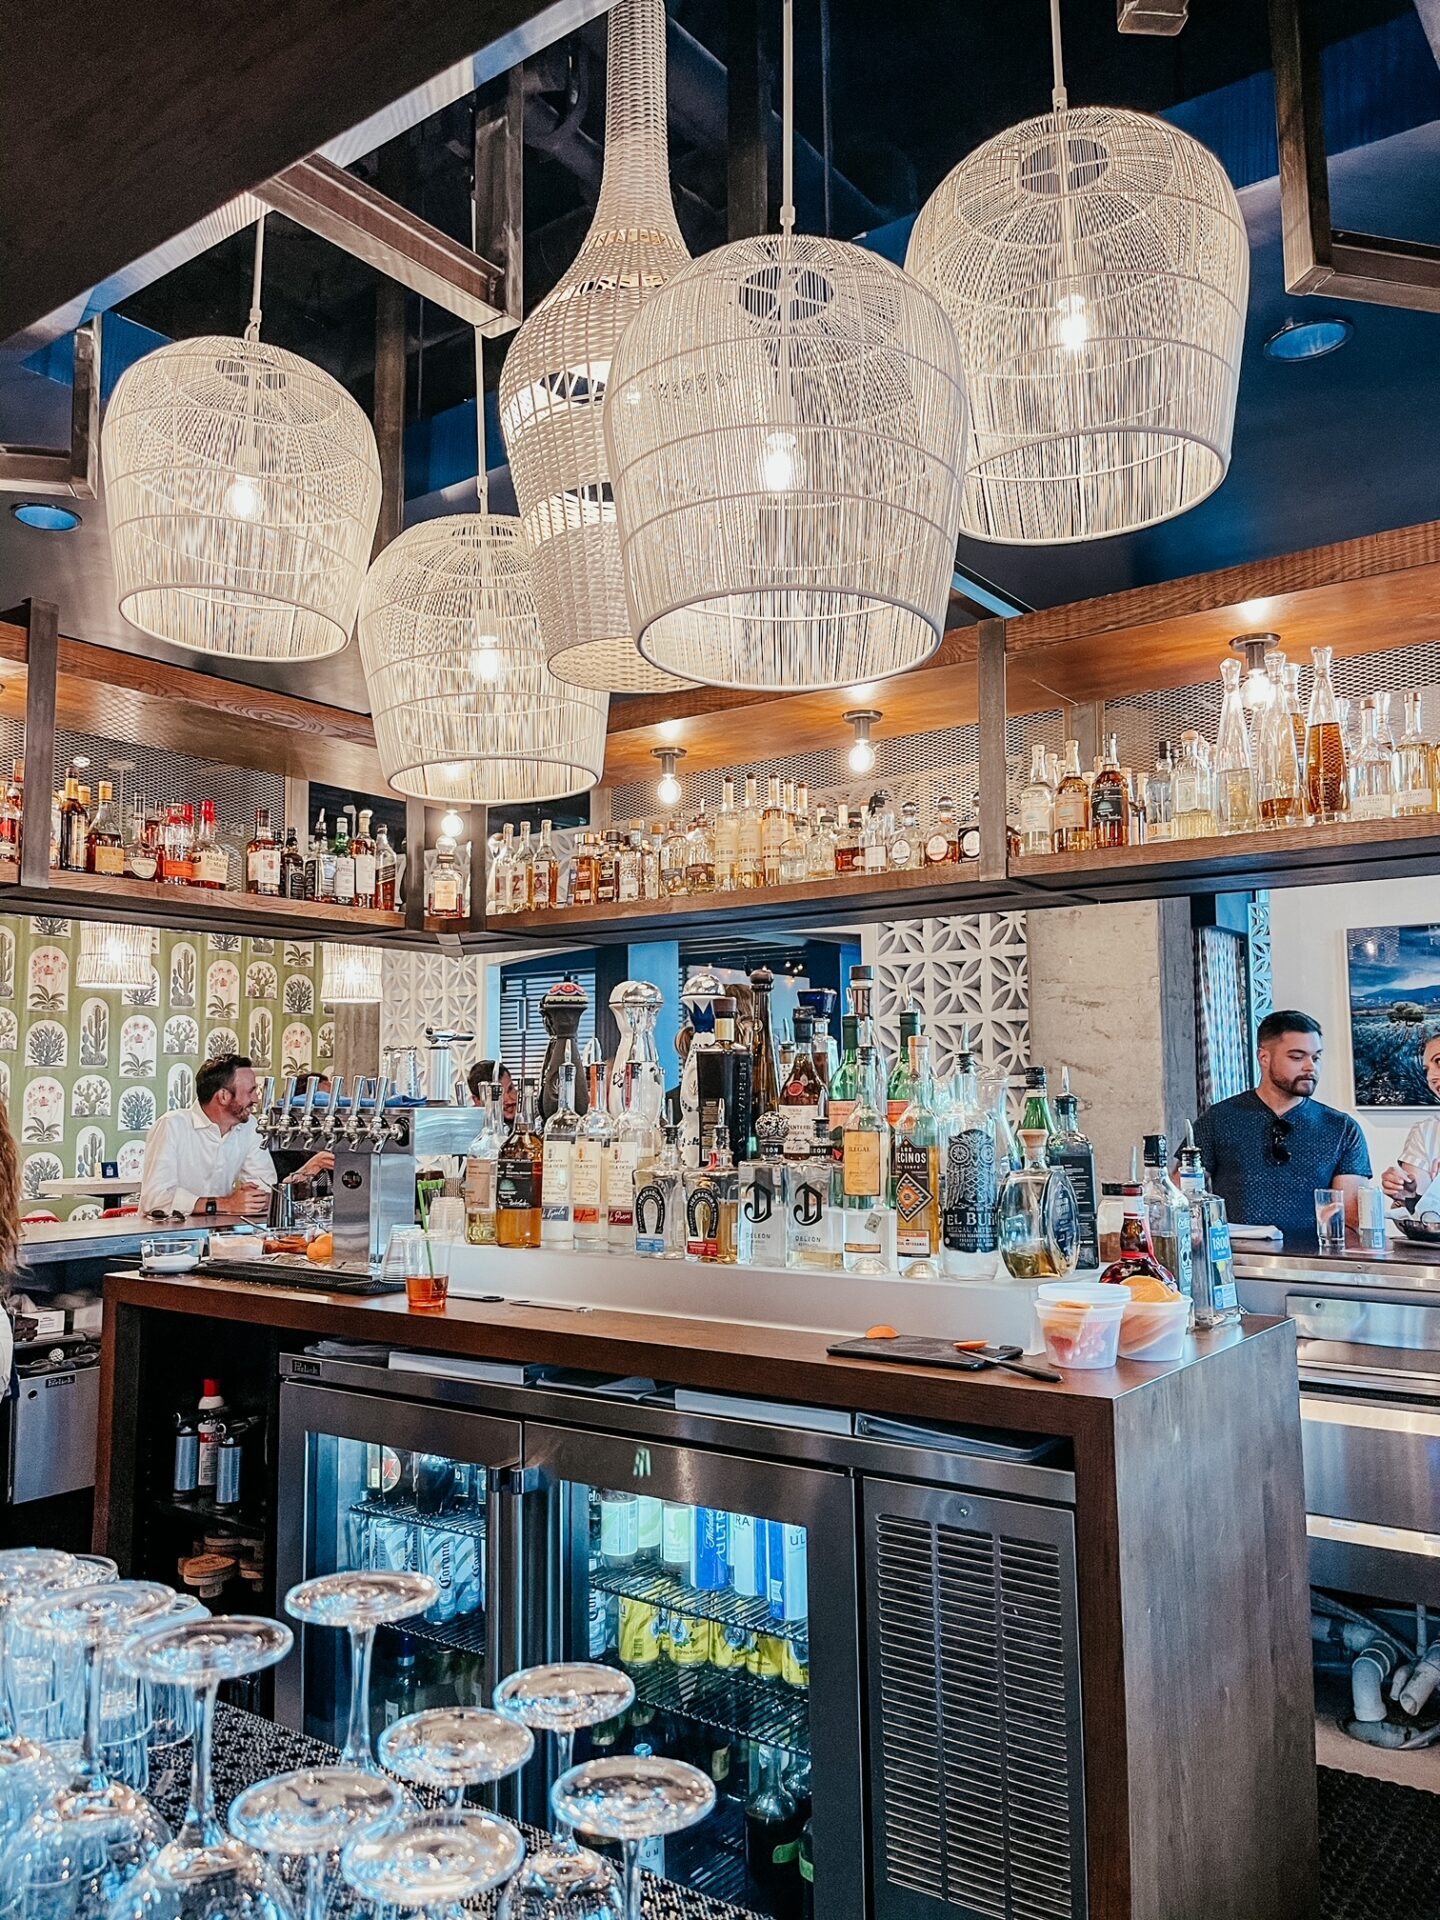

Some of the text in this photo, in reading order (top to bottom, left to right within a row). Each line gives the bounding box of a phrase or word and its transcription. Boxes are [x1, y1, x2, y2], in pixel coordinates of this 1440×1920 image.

[897, 1152, 926, 1164] ECINOS
[946, 1214, 962, 1226] EL
[589, 1490, 601, 1502] elo
[716, 1510, 726, 1556] ULTR
[439, 1541, 451, 1589] Corona
